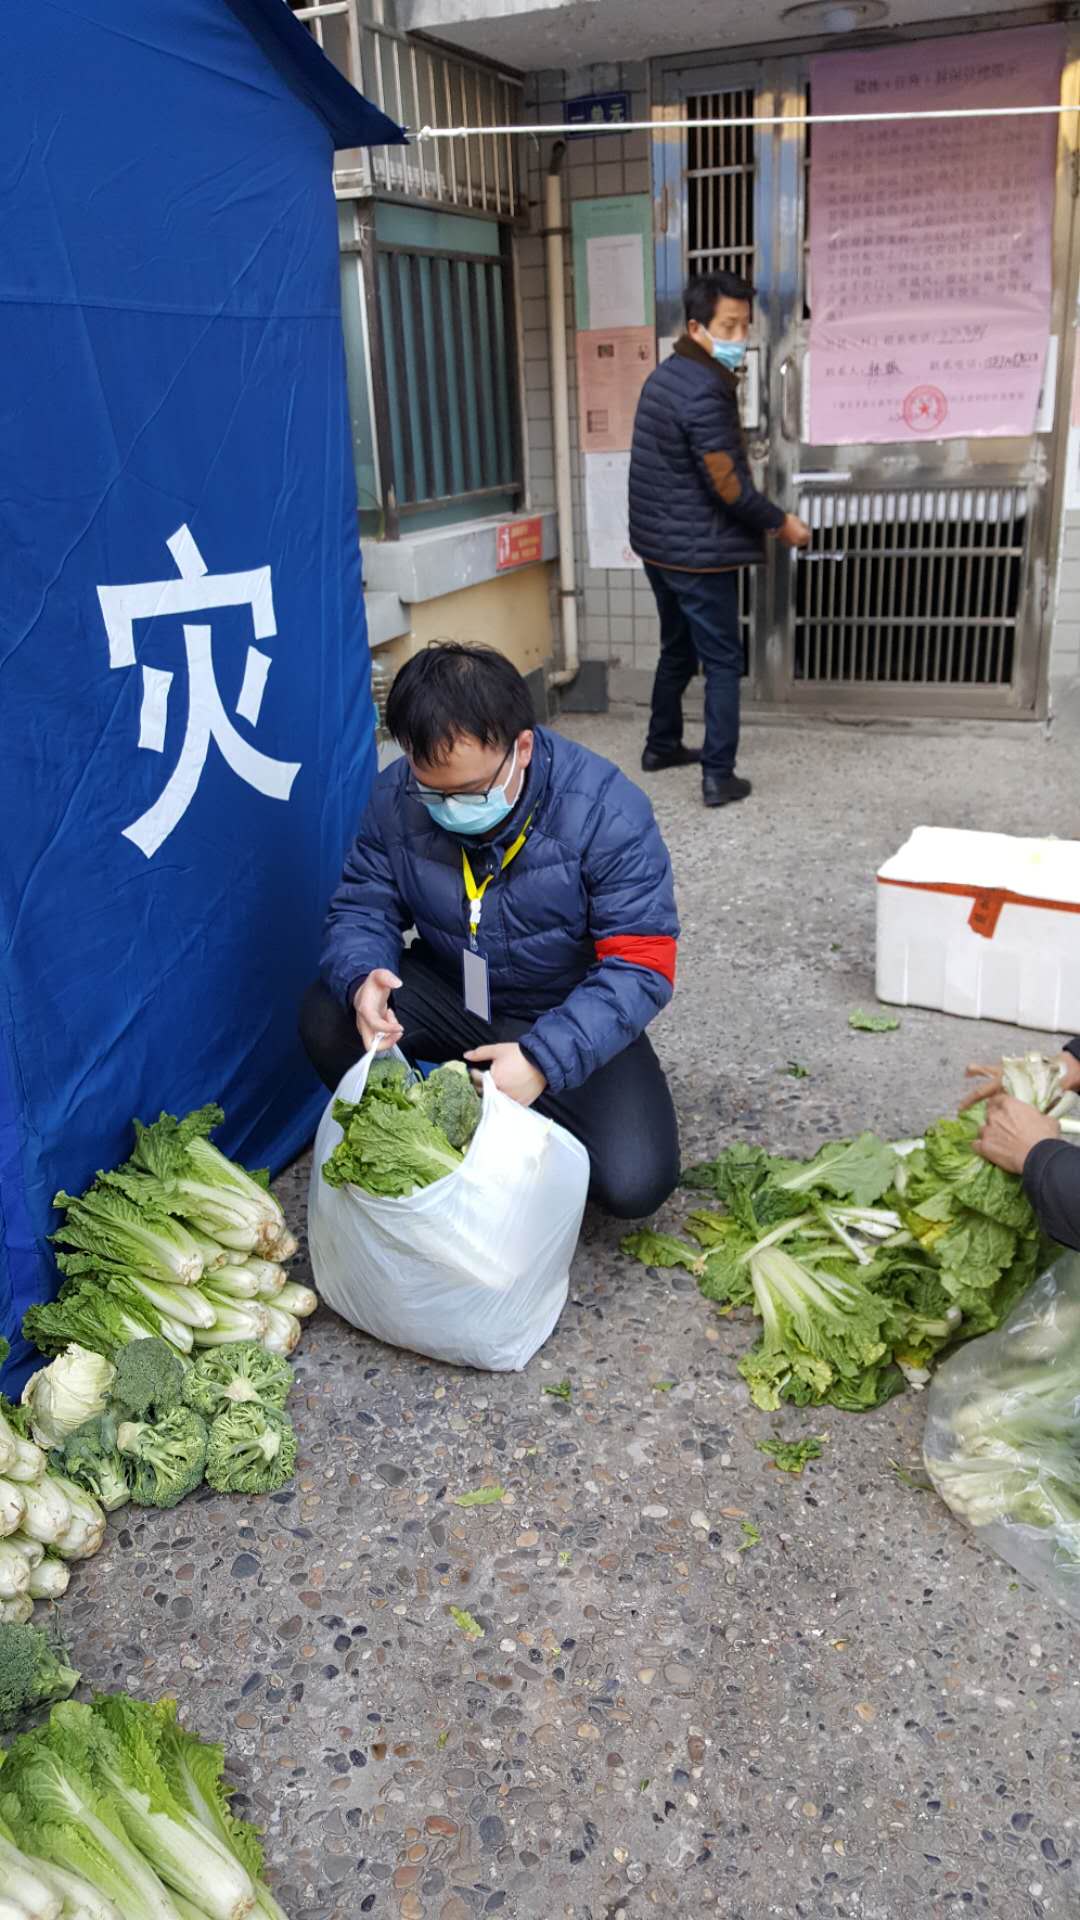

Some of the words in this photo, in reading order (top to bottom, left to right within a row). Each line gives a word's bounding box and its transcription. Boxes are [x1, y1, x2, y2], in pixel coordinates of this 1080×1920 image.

[570, 103, 625, 124] 一单元
[97, 523, 302, 859] 灾
